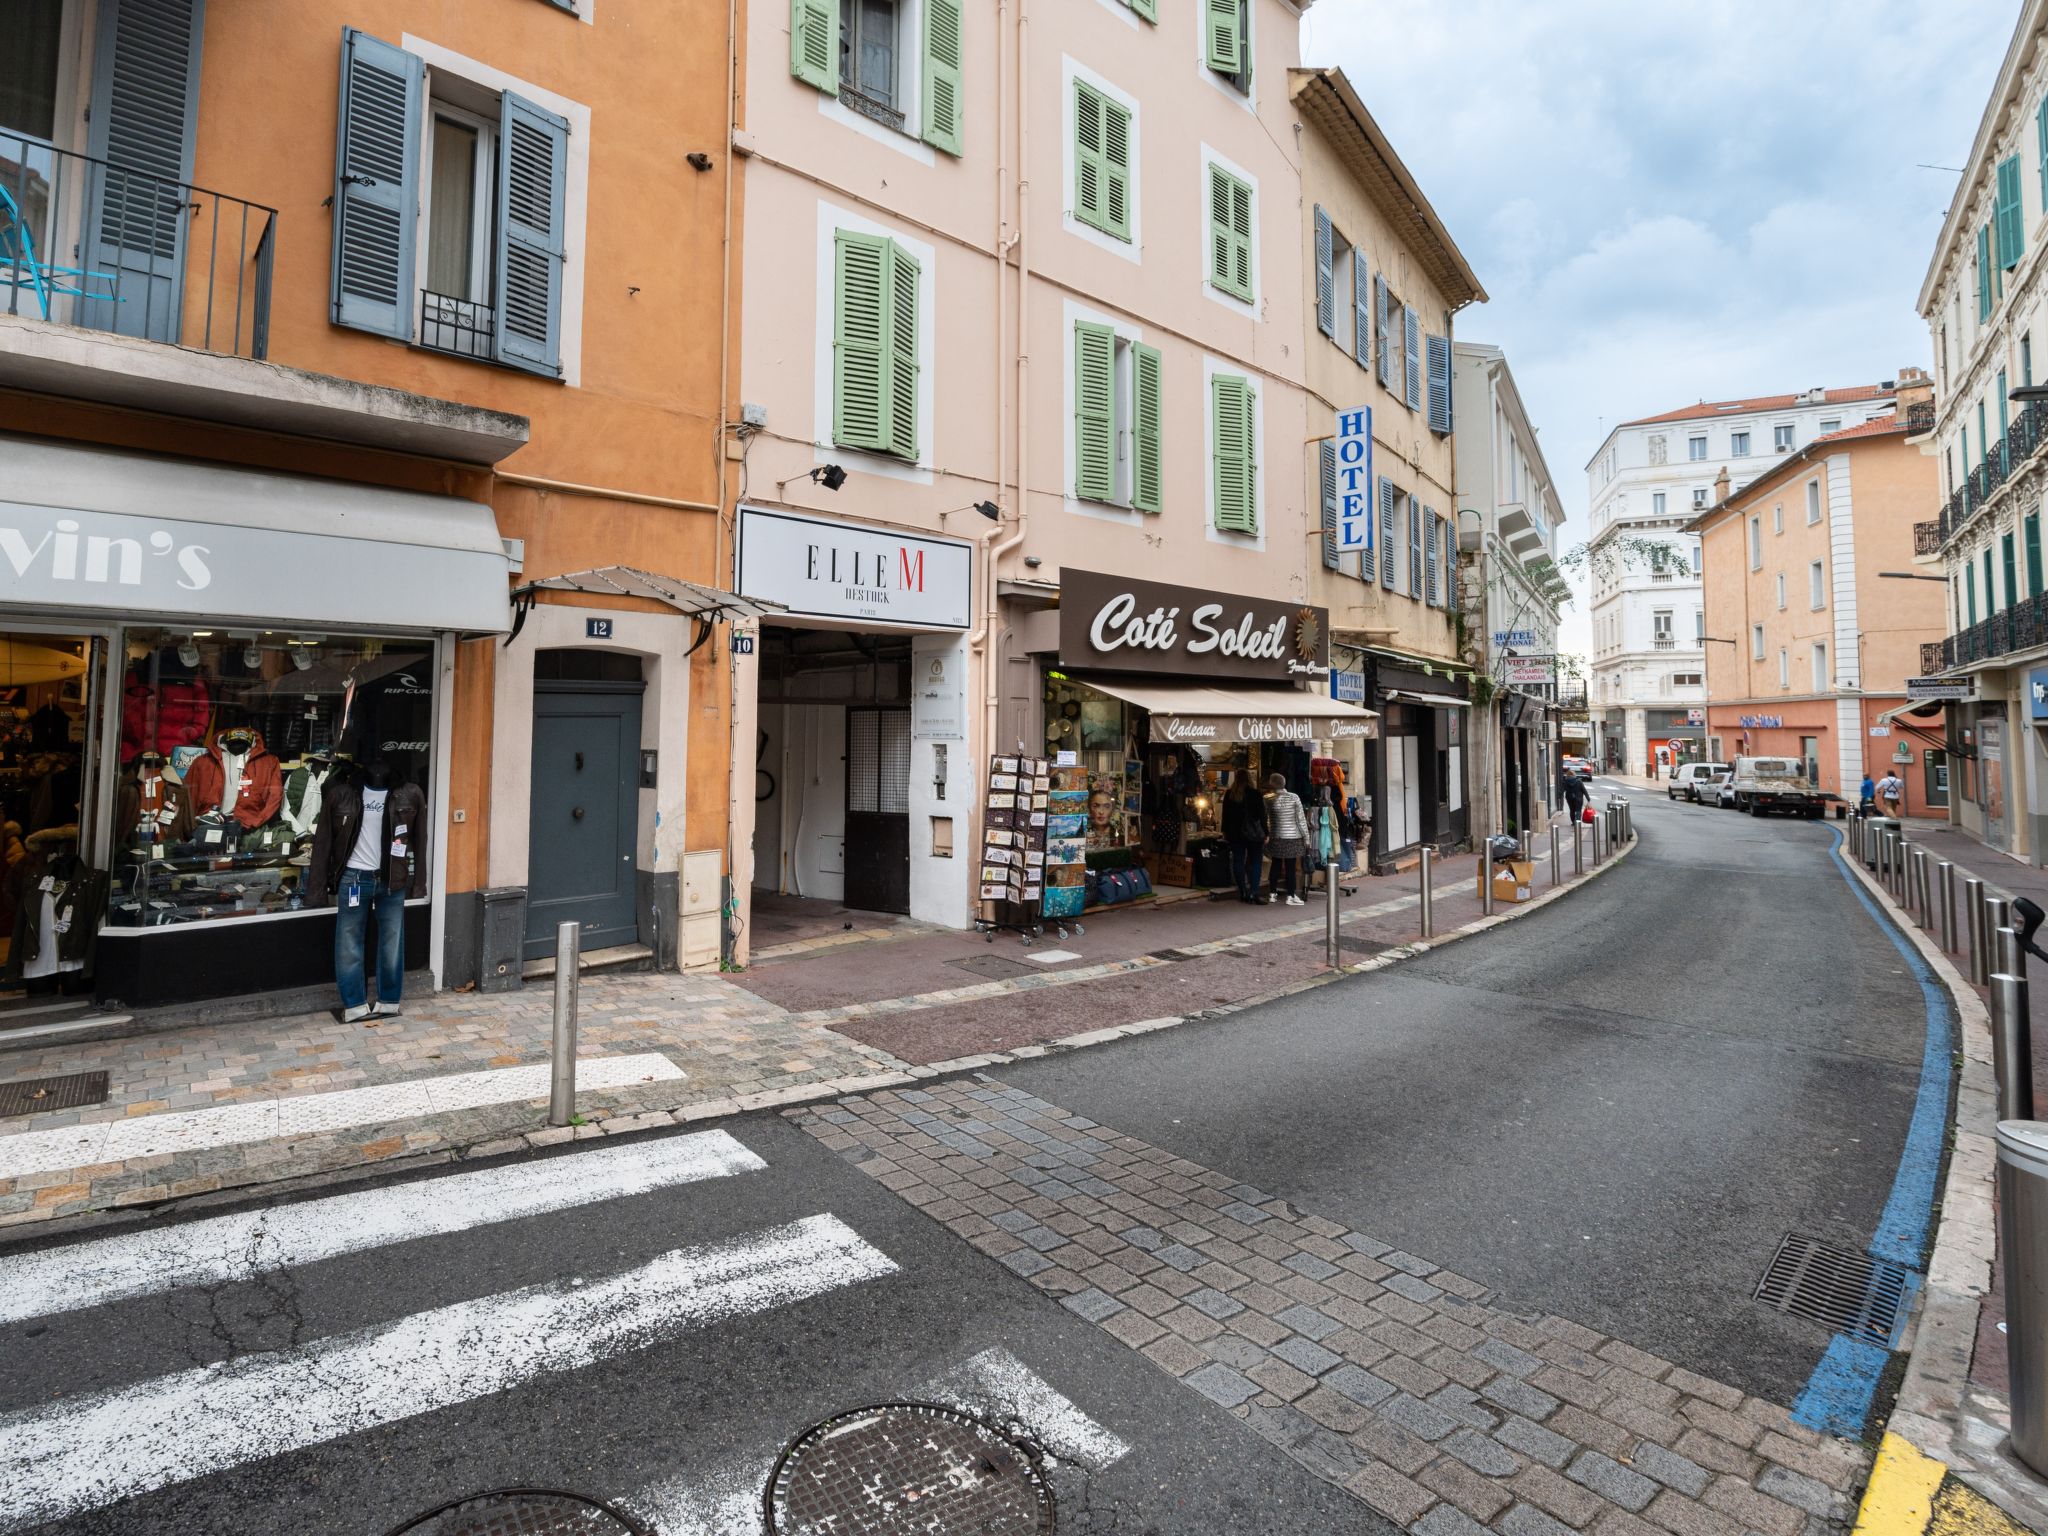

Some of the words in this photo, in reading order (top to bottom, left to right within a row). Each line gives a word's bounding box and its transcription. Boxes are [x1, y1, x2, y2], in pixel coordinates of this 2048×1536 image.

[1339, 411, 1364, 545] HOTEL
[593, 621, 607, 636] 12
[1089, 593, 1180, 652] Coté
[1187, 604, 1287, 660] Soleil
[736, 639, 751, 653] 10
[1339, 673, 1363, 689] HOTEL
[1167, 717, 1216, 740] Cadeaux
[1238, 717, 1272, 740] Côté
[1276, 717, 1313, 740] Soleil
